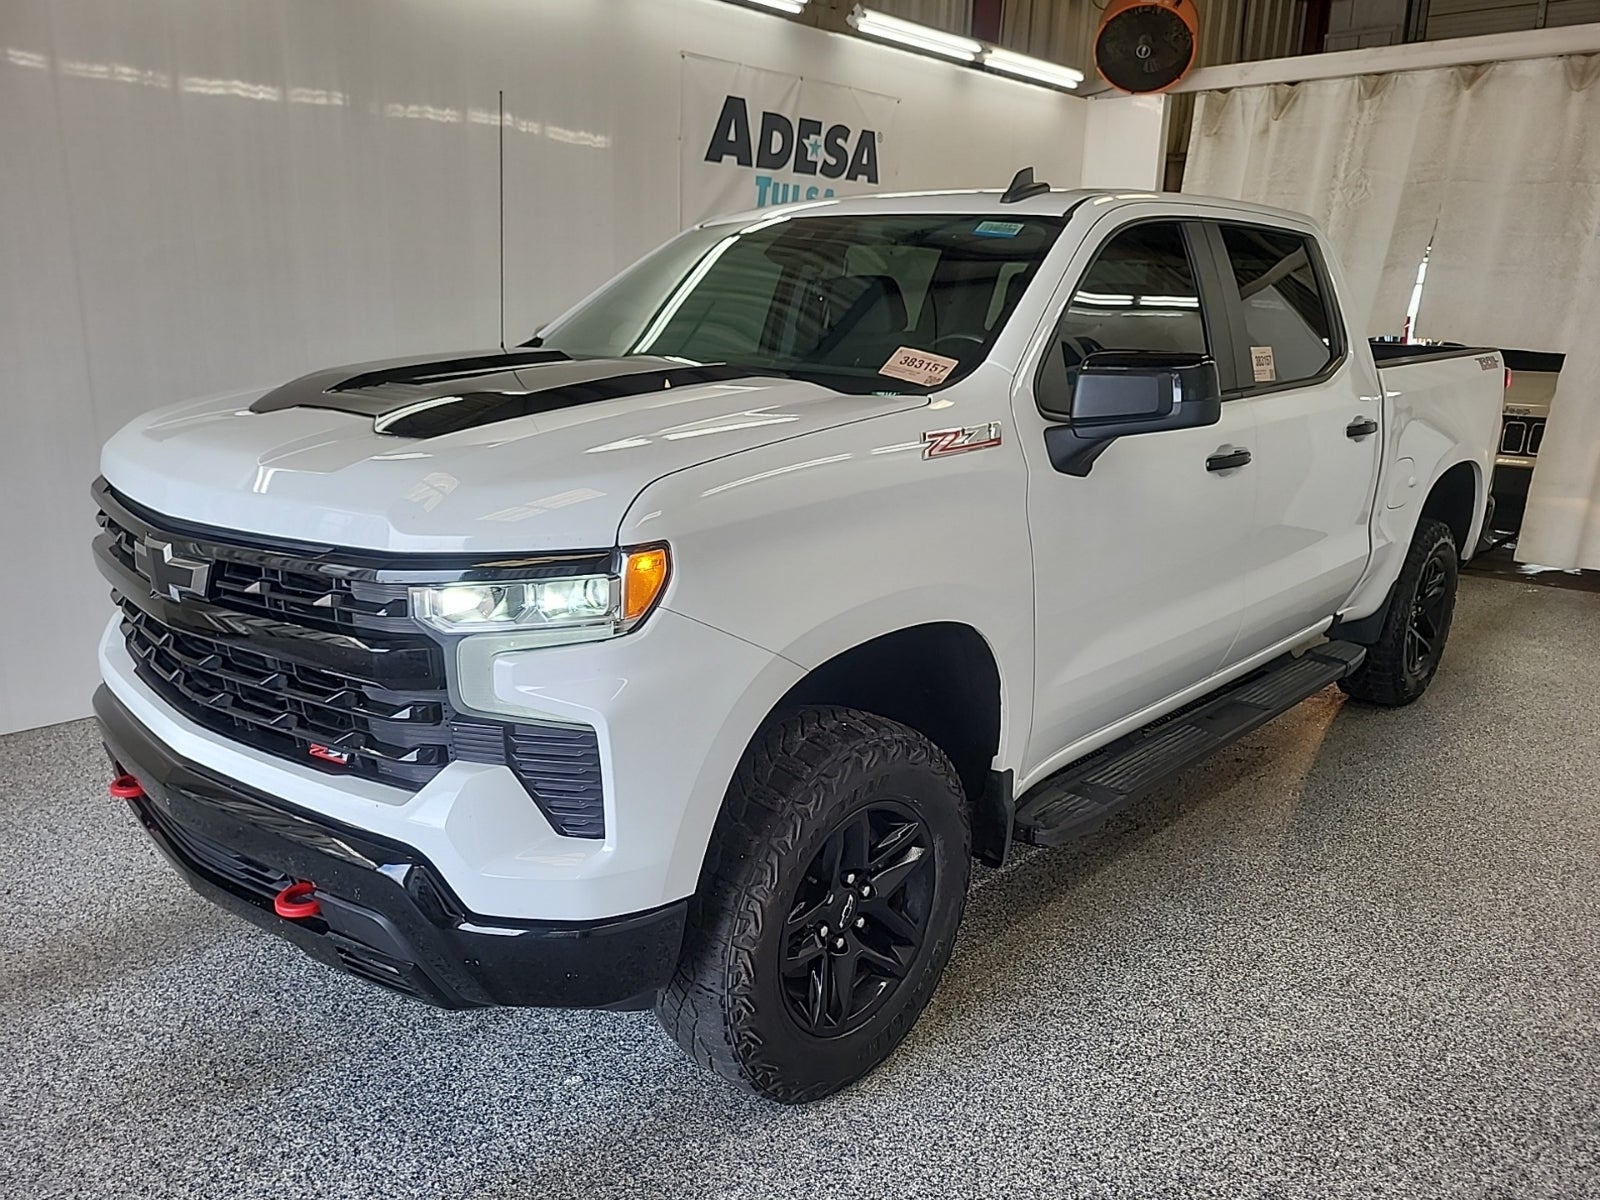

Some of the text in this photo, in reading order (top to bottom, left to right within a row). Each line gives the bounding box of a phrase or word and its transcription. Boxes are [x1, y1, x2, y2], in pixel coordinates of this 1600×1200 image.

[704, 95, 878, 185] ADESA
[899, 355, 949, 375] 383157
[921, 421, 1001, 460] Z71
[309, 743, 348, 765] Z71
